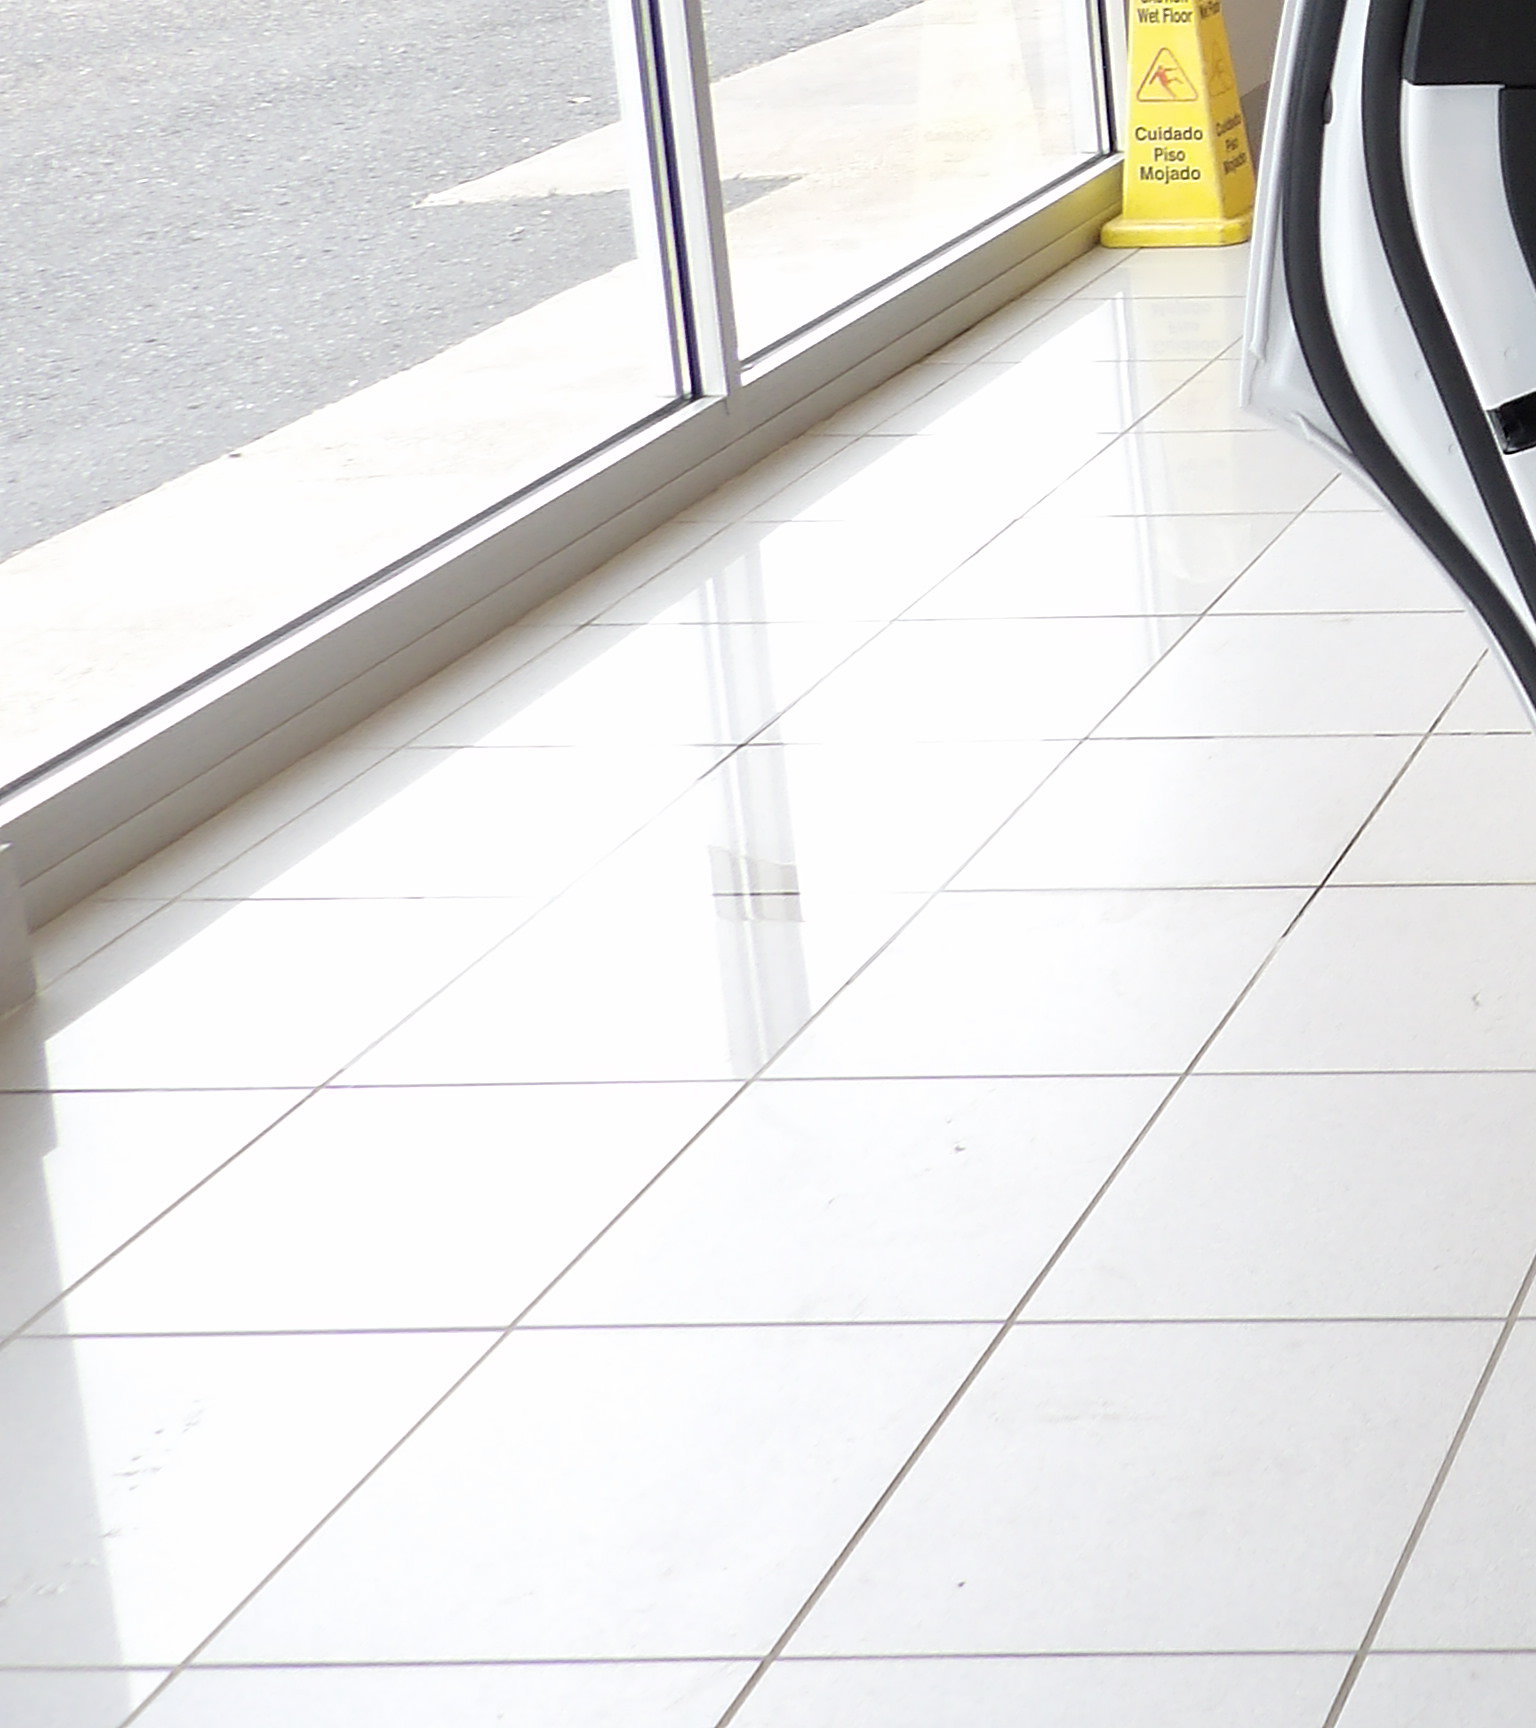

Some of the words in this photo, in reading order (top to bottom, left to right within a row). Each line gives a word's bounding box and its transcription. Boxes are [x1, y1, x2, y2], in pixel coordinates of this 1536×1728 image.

[1137, 8, 1160, 23] Wet
[1163, 7, 1193, 23] Floor
[1135, 126, 1203, 141] Cuidado
[1154, 147, 1186, 162] Piso
[1140, 165, 1201, 184] Mojado
